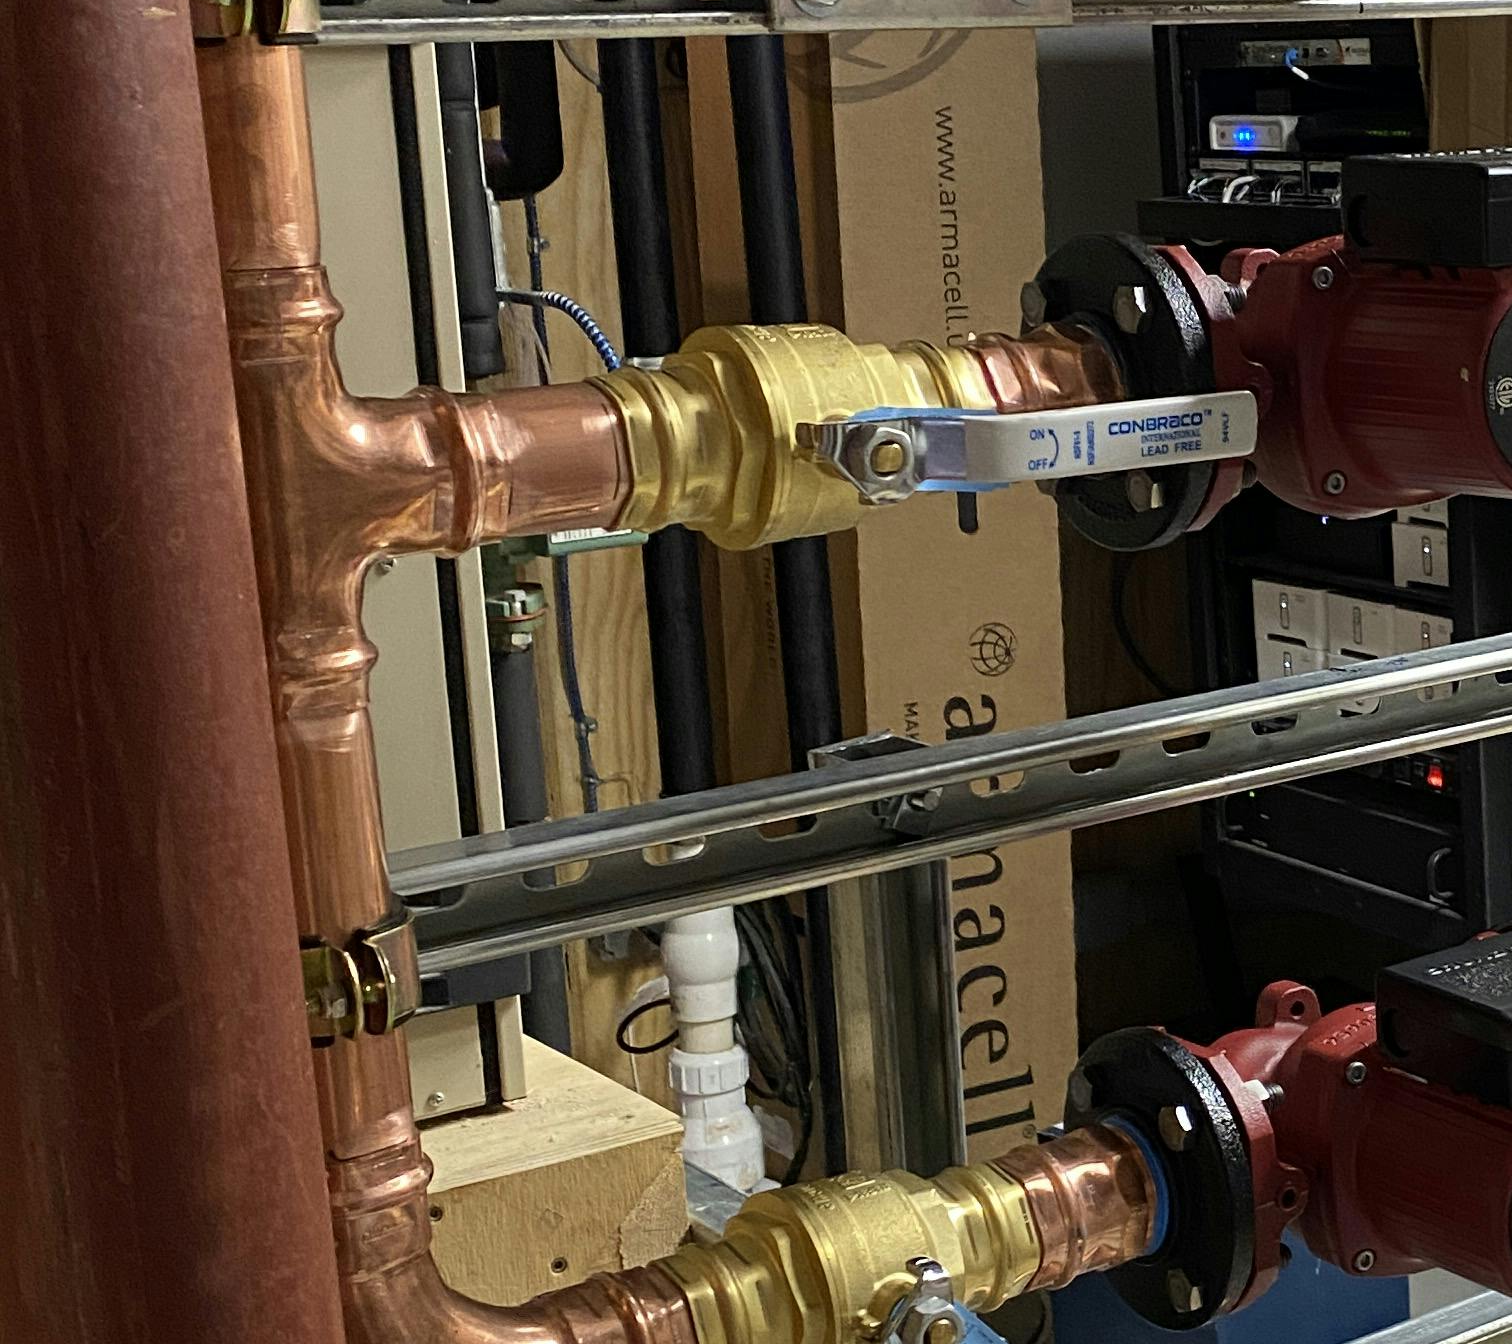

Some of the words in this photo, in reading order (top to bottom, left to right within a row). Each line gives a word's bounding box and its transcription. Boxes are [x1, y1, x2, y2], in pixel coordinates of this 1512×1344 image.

[1029, 428, 1046, 441] ON
[1140, 444, 1169, 458] LEAD
[1173, 440, 1203, 455] FREE
[1027, 458, 1049, 472] OFF
